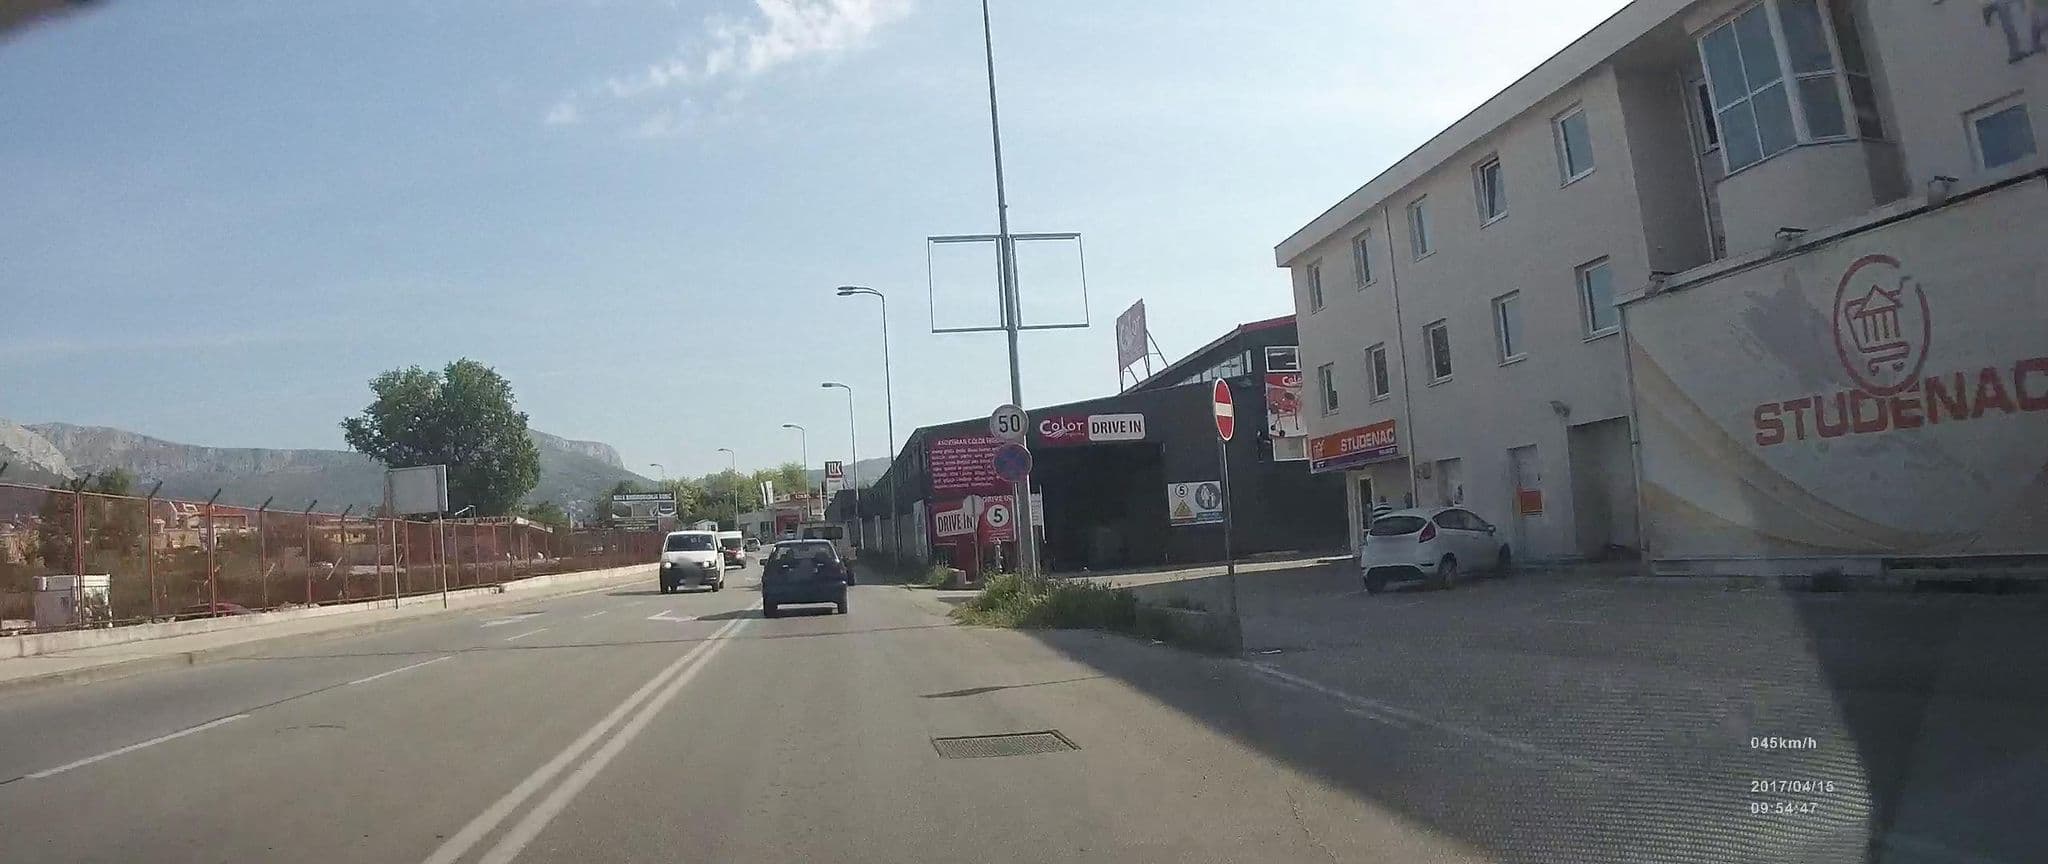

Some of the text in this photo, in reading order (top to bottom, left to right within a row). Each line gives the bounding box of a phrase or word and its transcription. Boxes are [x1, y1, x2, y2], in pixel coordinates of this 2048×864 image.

[1754, 357, 2048, 447] STUDENAC
[999, 414, 1021, 433] 50
[1039, 416, 1085, 436] Color
[1092, 420, 1142, 435] DRIVE IN
[1341, 428, 1394, 452] STUDENAC
[1180, 485, 1185, 496] 5
[938, 514, 961, 532] DRIVE
[994, 508, 1003, 523] 5
